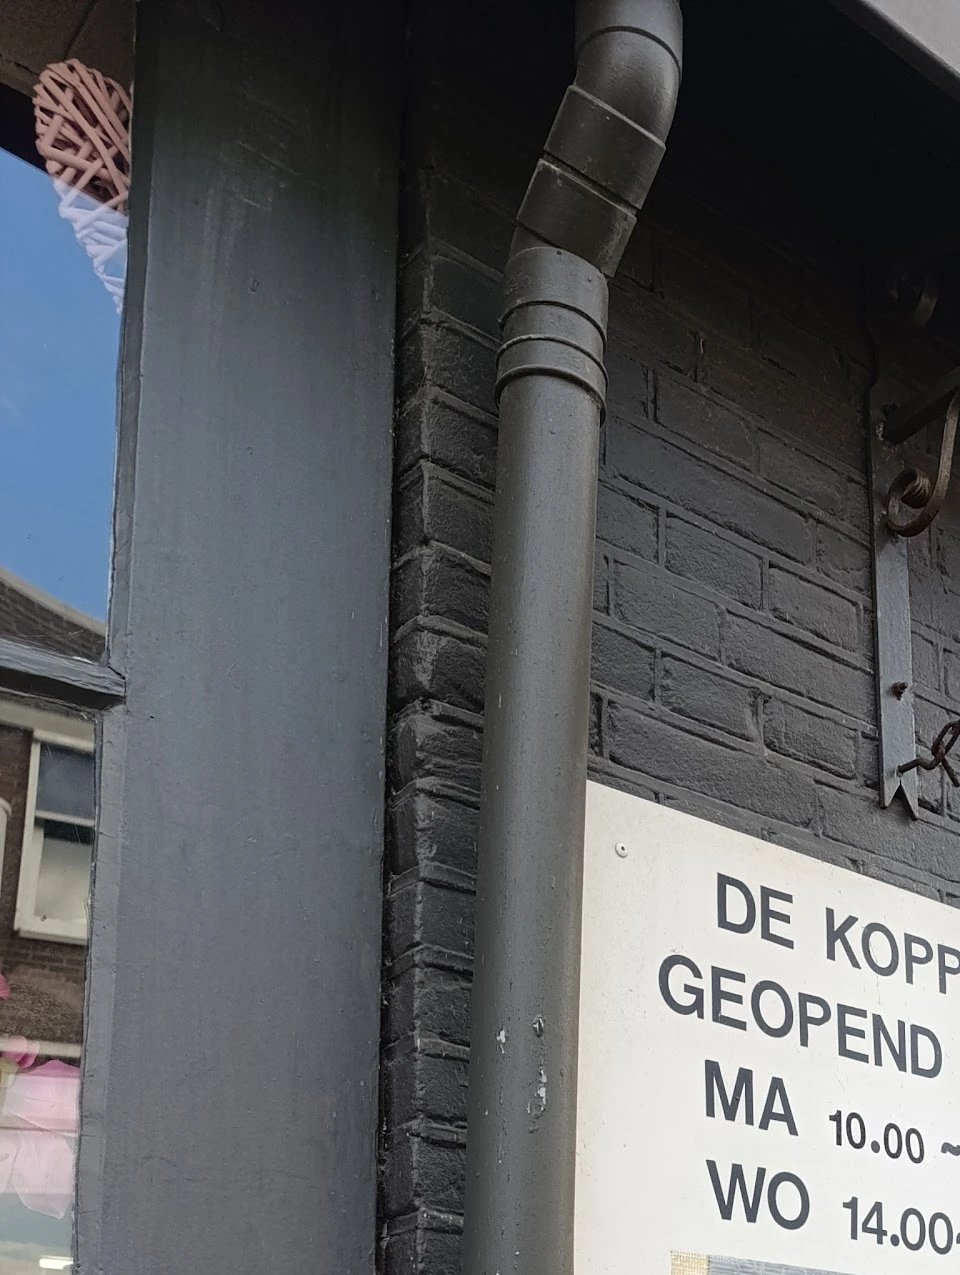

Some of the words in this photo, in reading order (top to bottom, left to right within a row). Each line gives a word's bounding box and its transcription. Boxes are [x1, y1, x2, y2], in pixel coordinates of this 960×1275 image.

[716, 872, 794, 960] DE
[658, 954, 943, 1079] GEOPEND
[704, 1059, 799, 1137] MA
[705, 1159, 810, 1231] WO
